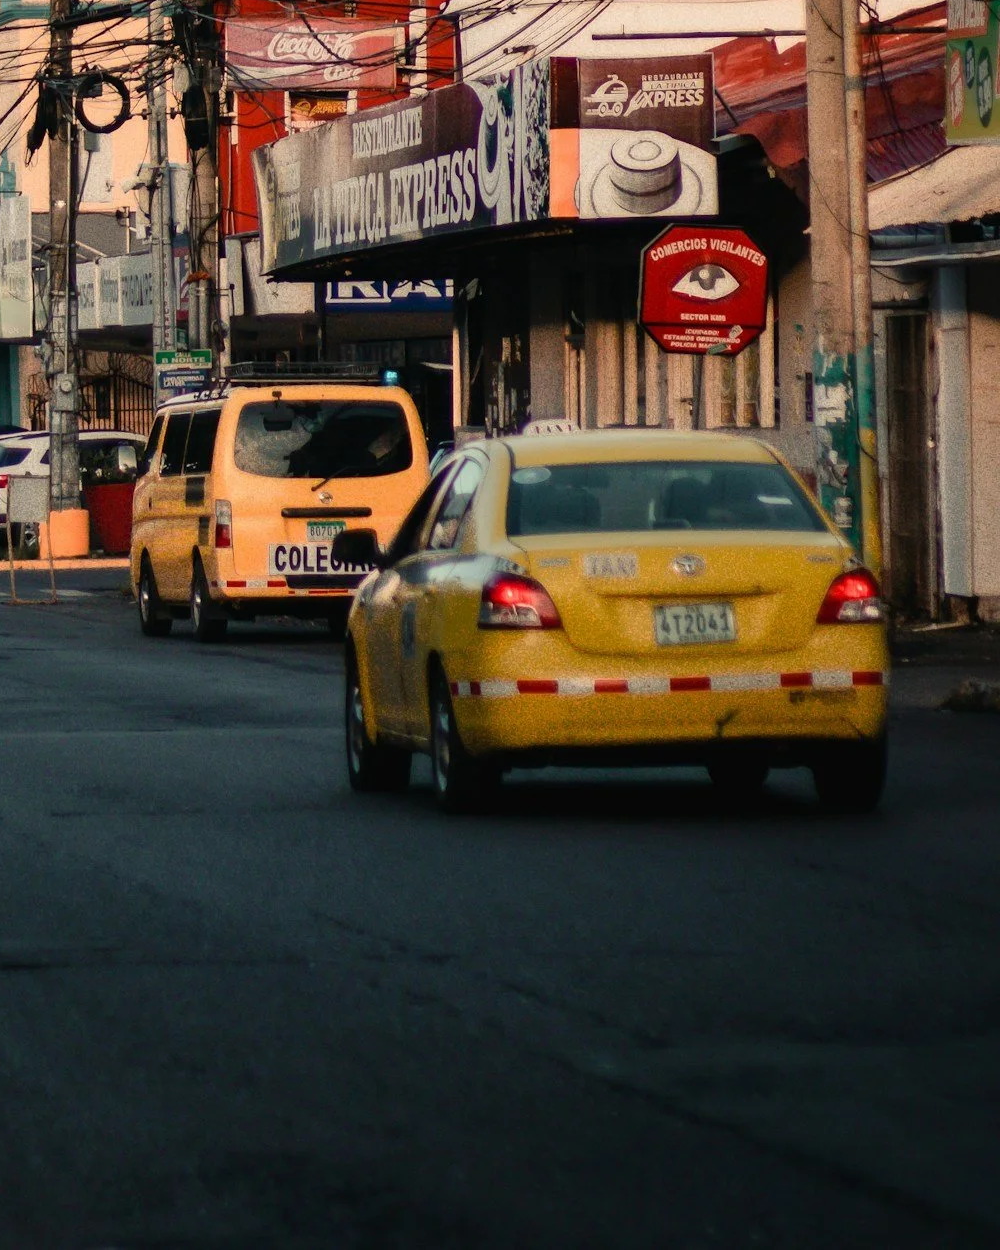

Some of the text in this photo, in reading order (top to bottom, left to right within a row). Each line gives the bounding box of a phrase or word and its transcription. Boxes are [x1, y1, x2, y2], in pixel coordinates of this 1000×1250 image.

[641, 71, 704, 81] RESTAURANTE
[650, 82, 663, 90] LA
[352, 106, 423, 160] RESTAURANTE
[313, 186, 332, 251] LA
[332, 171, 387, 244] TIPICA
[389, 147, 476, 237] EXPRESS
[650, 237, 767, 267] COMERCIOS VIGILANTES
[680, 313, 709, 321] SECTOR
[171, 356, 206, 364] NORTE
